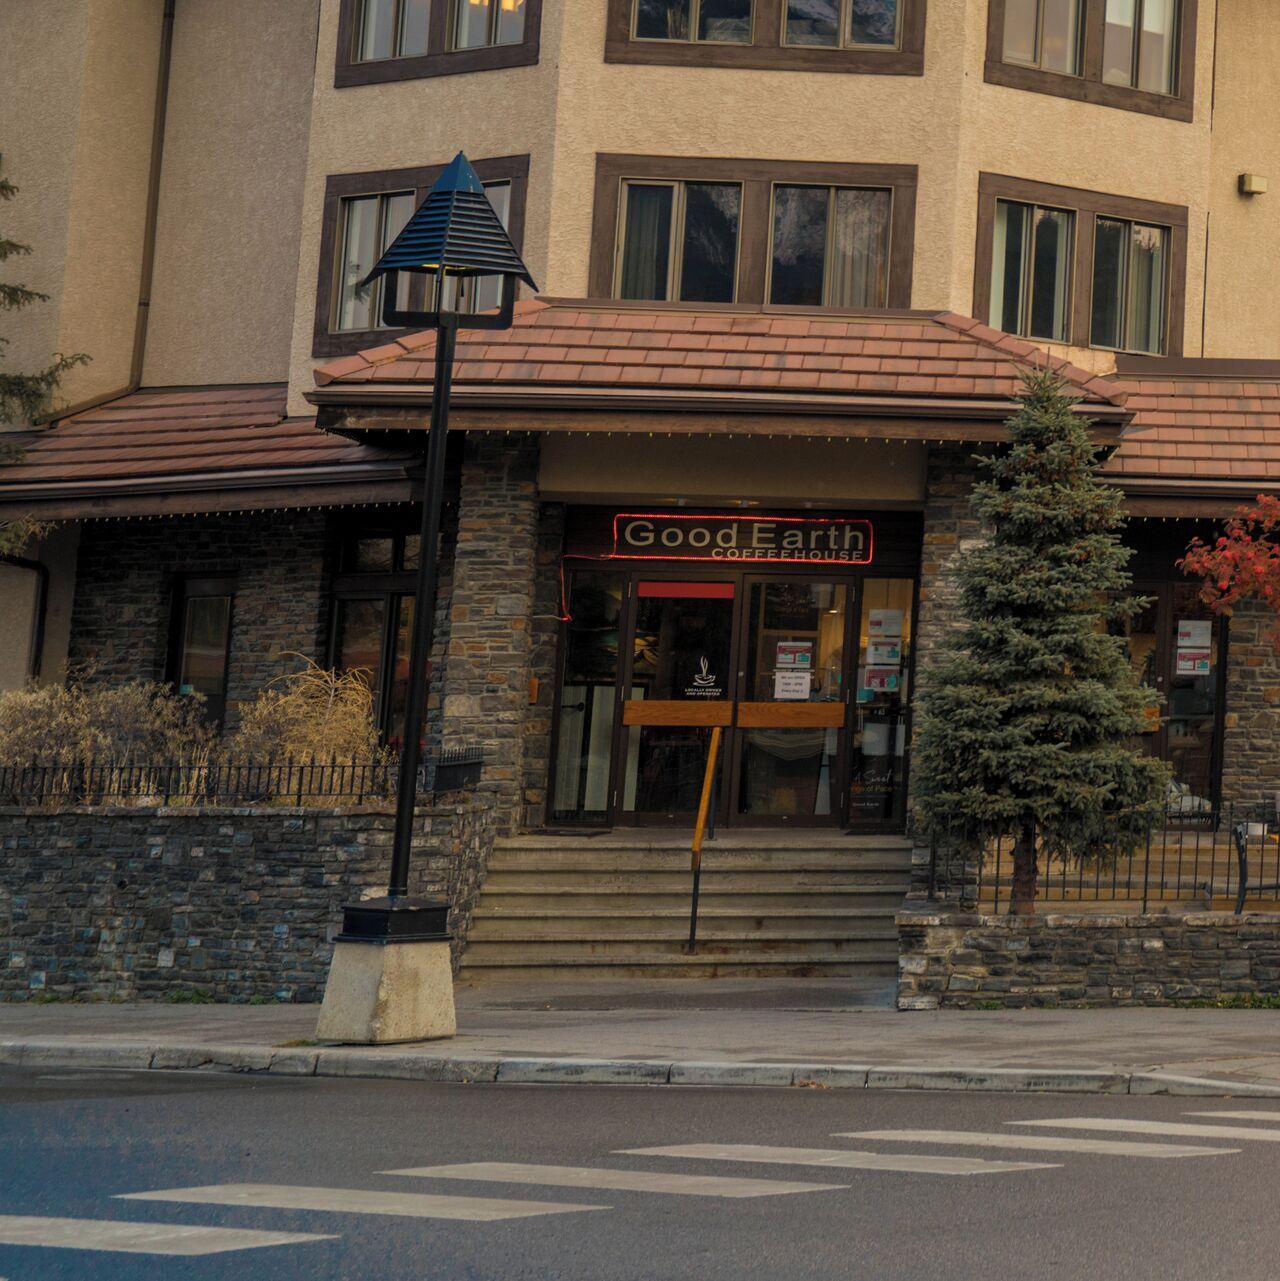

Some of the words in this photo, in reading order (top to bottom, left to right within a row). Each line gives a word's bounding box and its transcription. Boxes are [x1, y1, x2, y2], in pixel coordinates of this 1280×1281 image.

[624, 520, 738, 548] Good
[752, 522, 864, 550] Earth
[711, 548, 862, 561] COFFEEHOUSE
